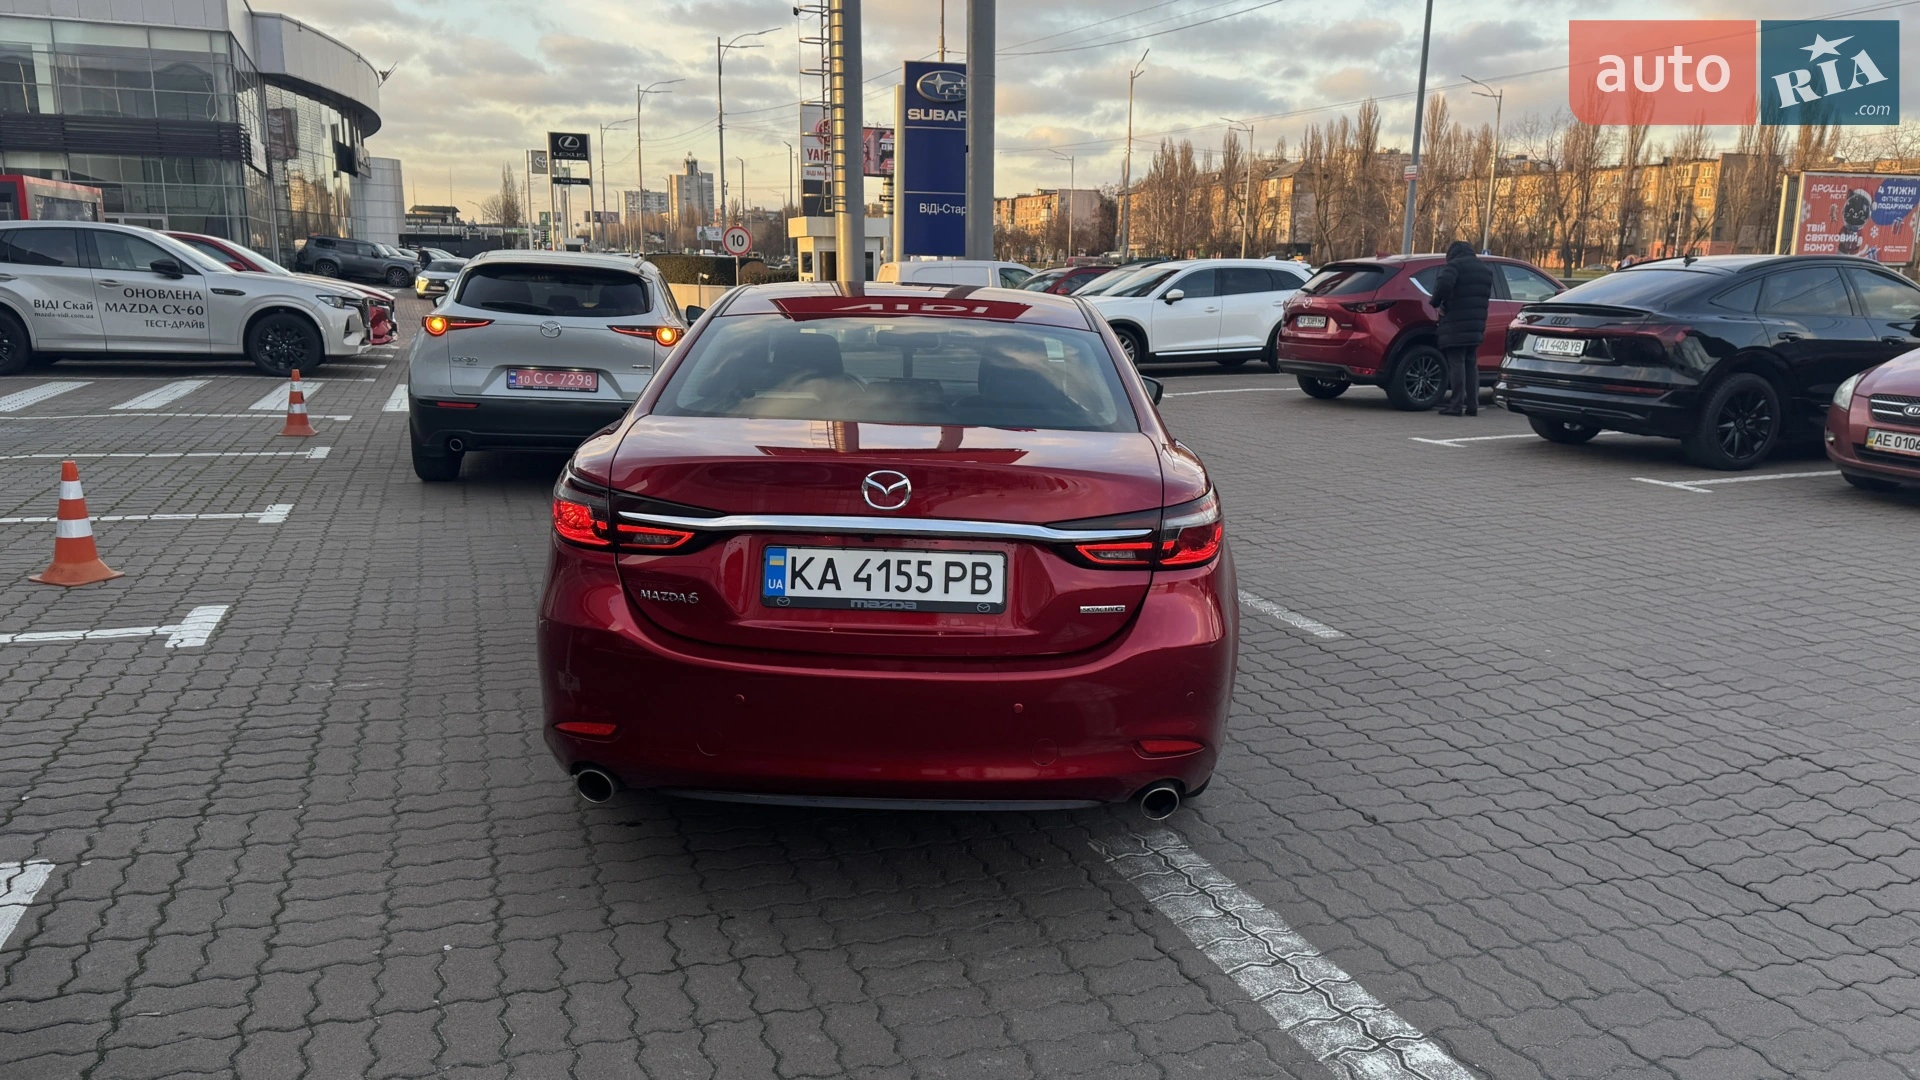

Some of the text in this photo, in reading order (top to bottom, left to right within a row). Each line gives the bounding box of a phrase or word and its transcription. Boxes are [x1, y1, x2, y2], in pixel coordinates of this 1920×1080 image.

[907, 108, 967, 122] SUBAR
[1811, 184, 1848, 193] APOLLO
[1878, 185, 1917, 195] 4 ТИЖНІ
[1806, 222, 1826, 232] ТВІЙ
[731, 234, 744, 247] 10
[1805, 232, 1858, 242] СВЯТКОВИЙ
[1804, 243, 1834, 252] БОНУС
[123, 288, 203, 300] ОНОВЛЕНА
[33, 299, 94, 311] ВІДІ Скай
[104, 302, 204, 316] MAZDA CX-60
[144, 319, 205, 330] ТЕСТ-ДРАЙВ
[1551, 340, 1569, 350] 4408
[518, 372, 592, 387] 10 CC 7298
[1874, 433, 1893, 447] AE
[790, 556, 992, 595] KA 4155 PB
[768, 579, 784, 590] UA
